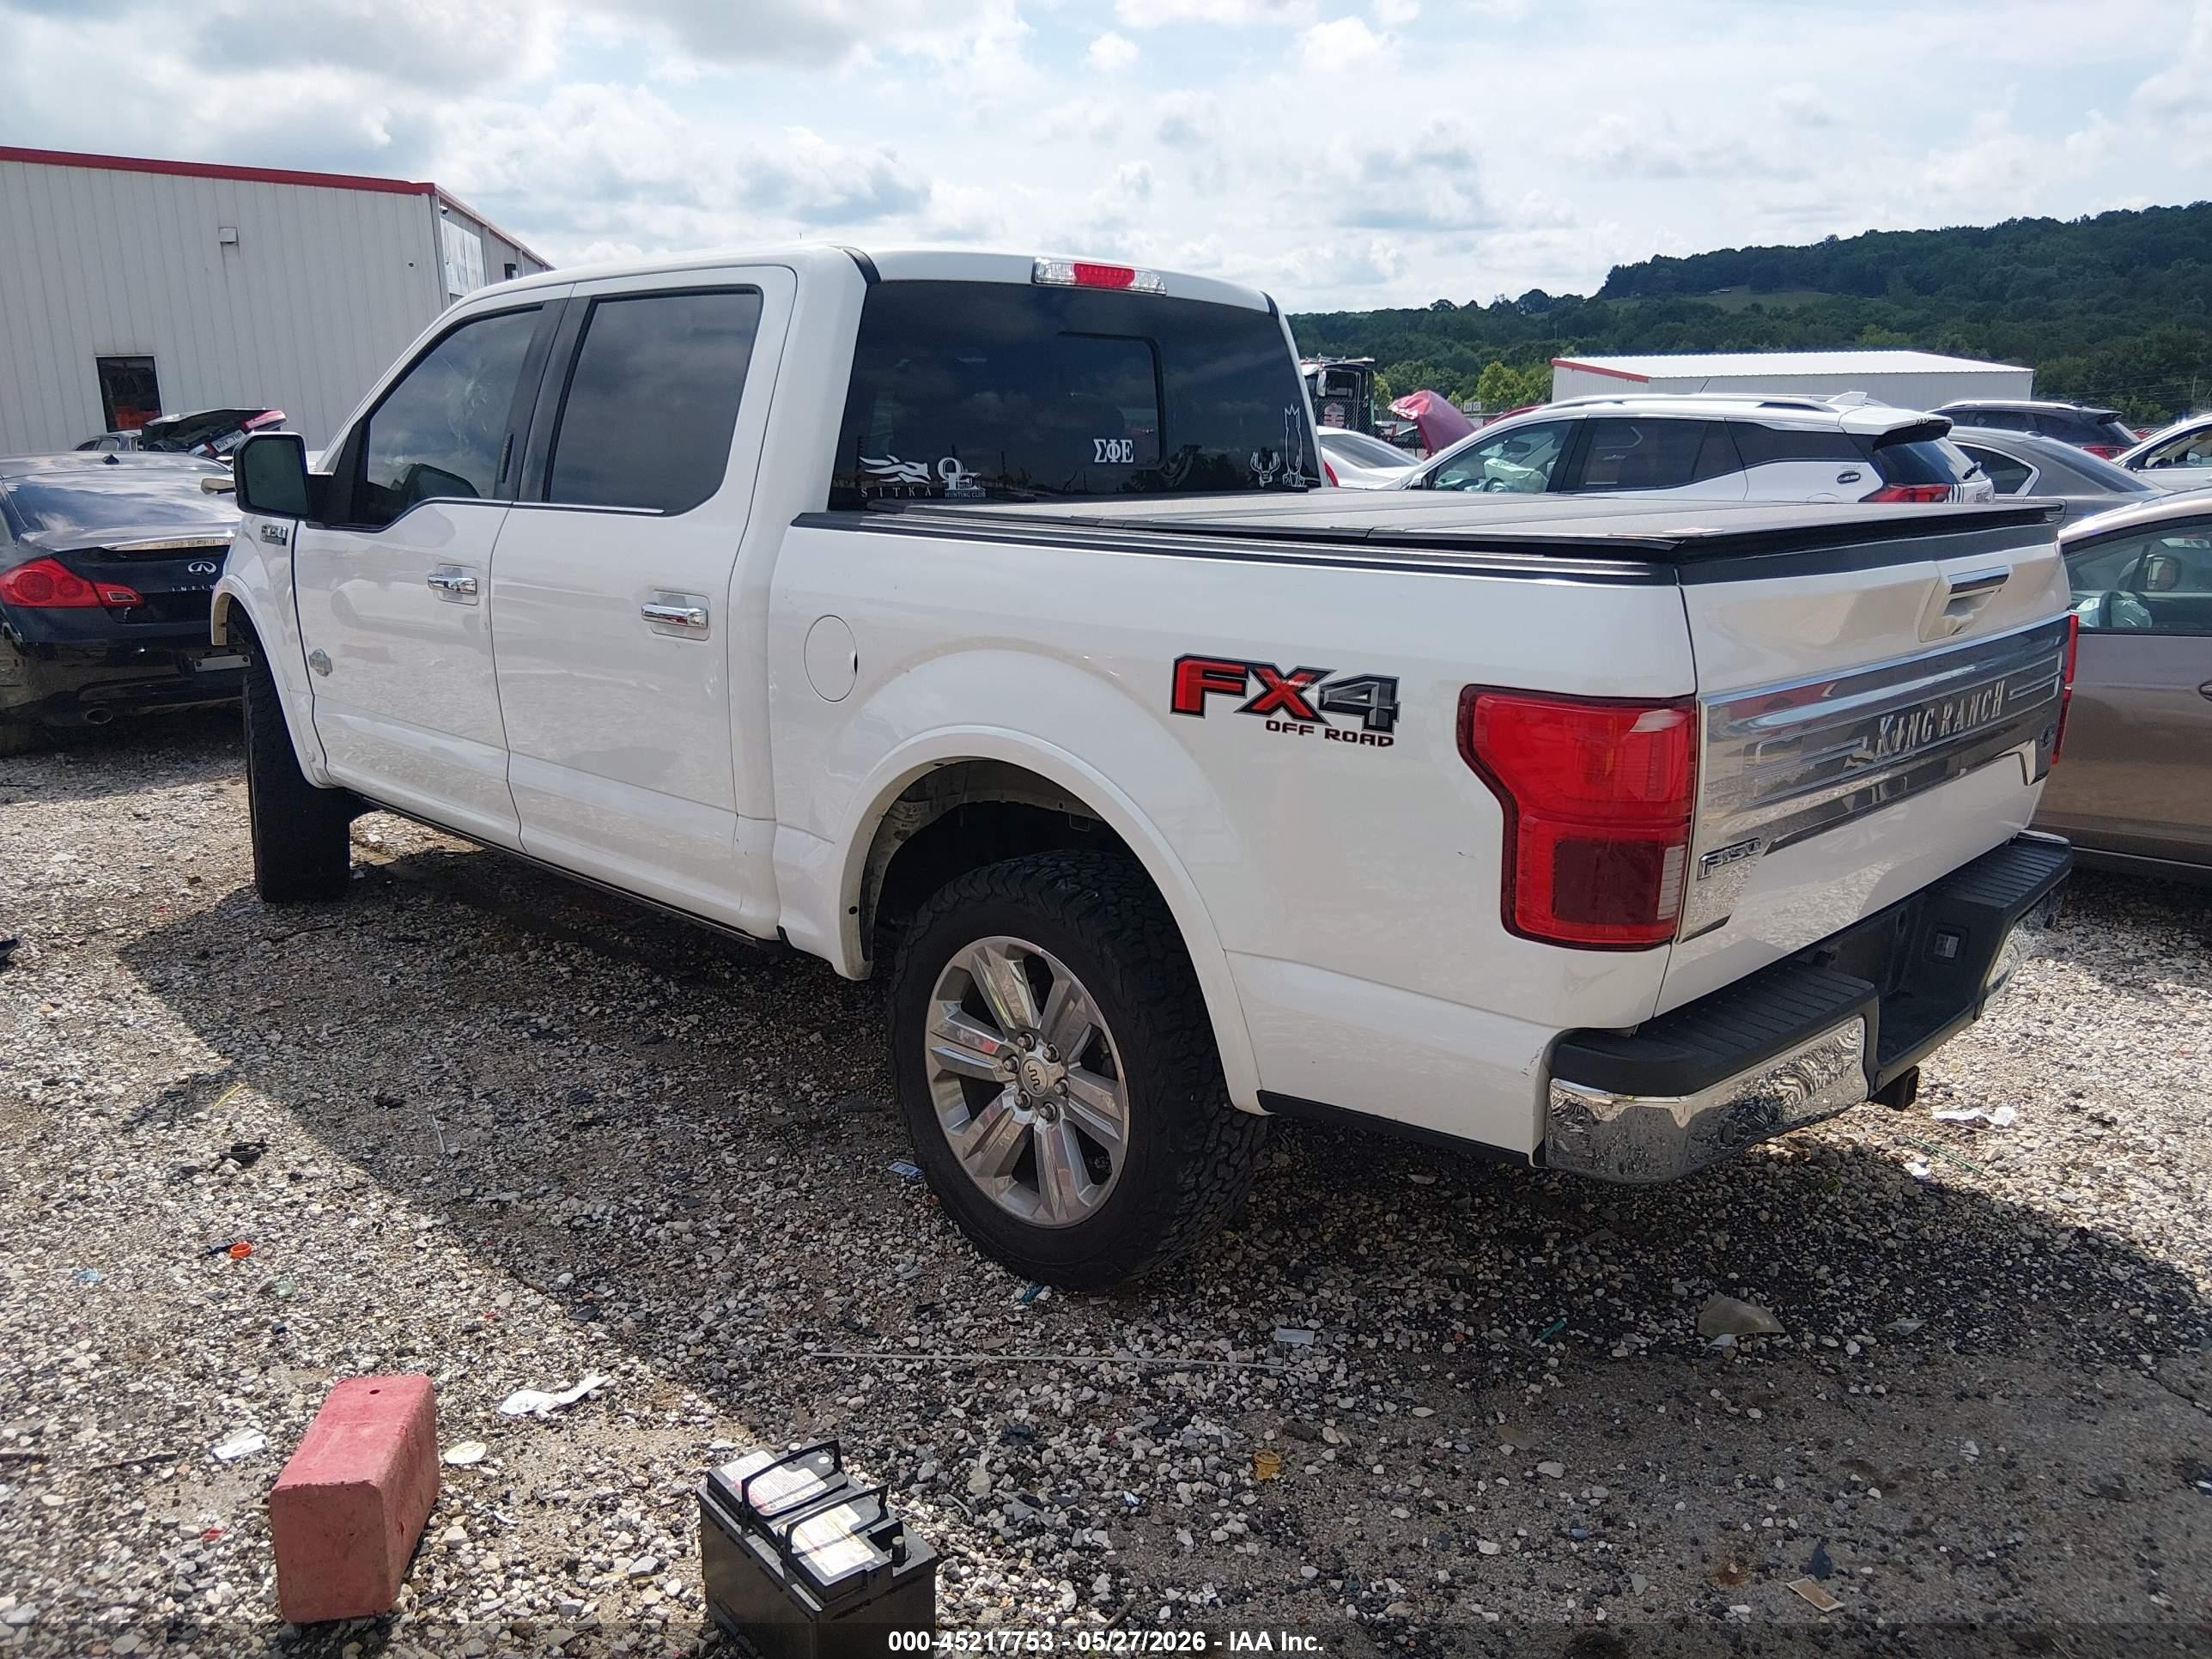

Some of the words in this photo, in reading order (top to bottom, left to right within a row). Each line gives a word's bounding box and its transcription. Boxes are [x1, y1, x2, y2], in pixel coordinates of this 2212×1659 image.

[861, 487, 933, 498] SITKA
[1170, 653, 1401, 736] FX4
[1873, 708, 1936, 763] KING
[1938, 680, 2006, 738] RANCH
[1265, 720, 1315, 736] OFF
[1323, 728, 1395, 748] ROAD
